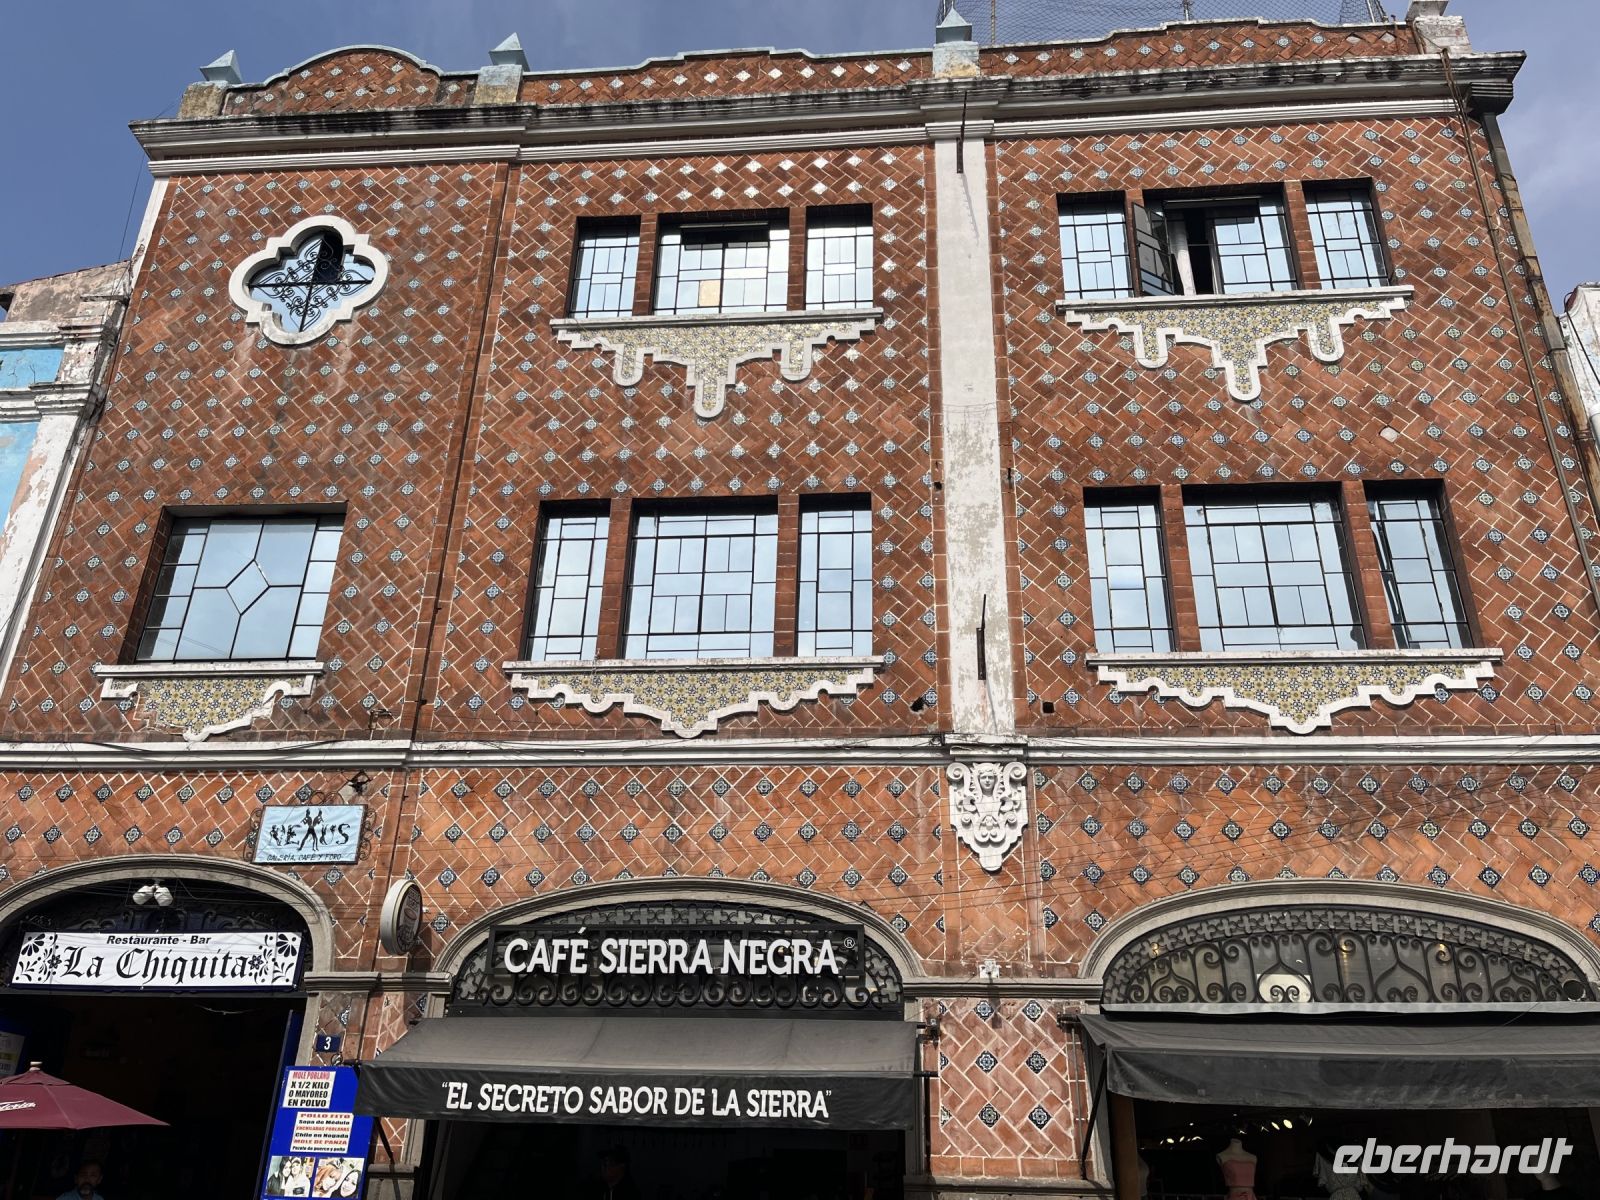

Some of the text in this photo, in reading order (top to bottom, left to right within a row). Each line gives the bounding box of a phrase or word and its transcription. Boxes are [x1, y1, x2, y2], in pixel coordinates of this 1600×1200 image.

[106, 935, 179, 945] Restaurante
[190, 935, 212, 945] Bar
[503, 927, 839, 975] CAFÉ SIERRA NEGRA
[60, 946, 104, 979] La
[323, 1036, 332, 1050] 3
[293, 1071, 306, 1079] MOLE
[312, 1081, 330, 1089] KILO
[295, 1090, 329, 1098] MAYOREO
[477, 1082, 584, 1114] SECRETO
[588, 1086, 667, 1115] SABOR
[675, 1088, 705, 1116] DE
[712, 1089, 741, 1116] LA
[288, 1098, 327, 1107] EN POLVO
